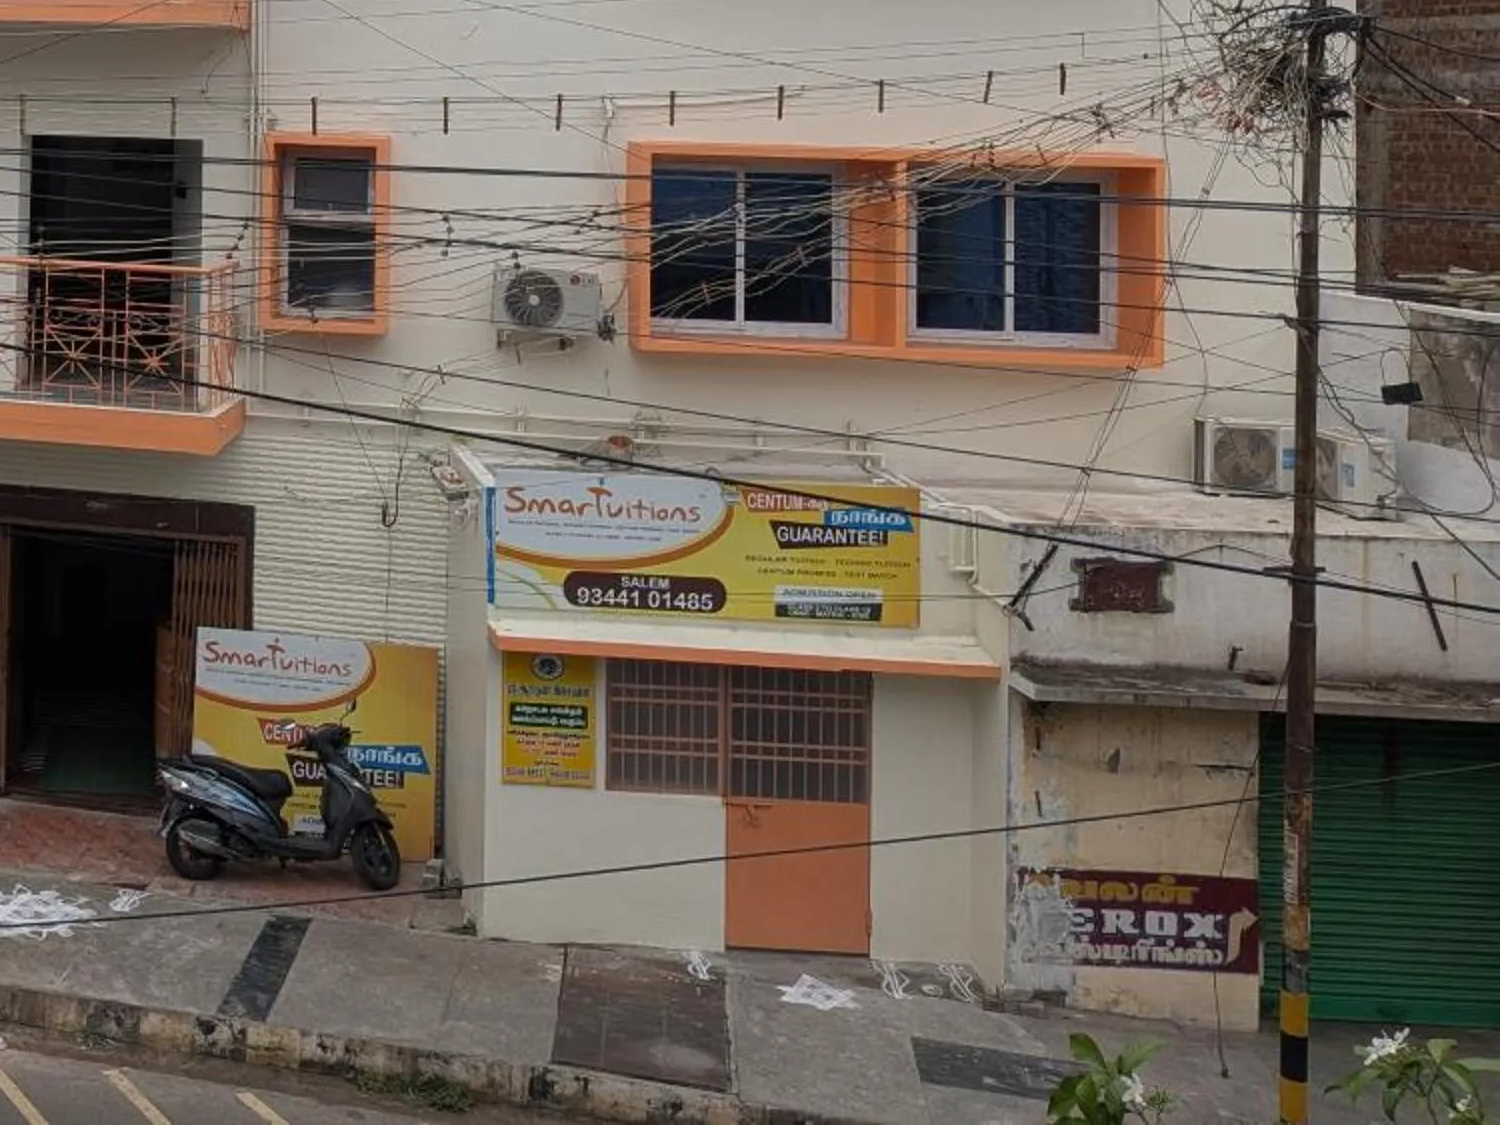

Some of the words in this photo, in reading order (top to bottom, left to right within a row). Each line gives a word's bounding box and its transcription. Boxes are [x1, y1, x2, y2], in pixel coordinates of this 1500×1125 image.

[776, 526, 884, 546] GUARANTEE!
[620, 576, 671, 589] SALEM
[576, 586, 639, 607] 93441
[648, 591, 714, 611] 01485
[1067, 908, 1224, 938] EROX
